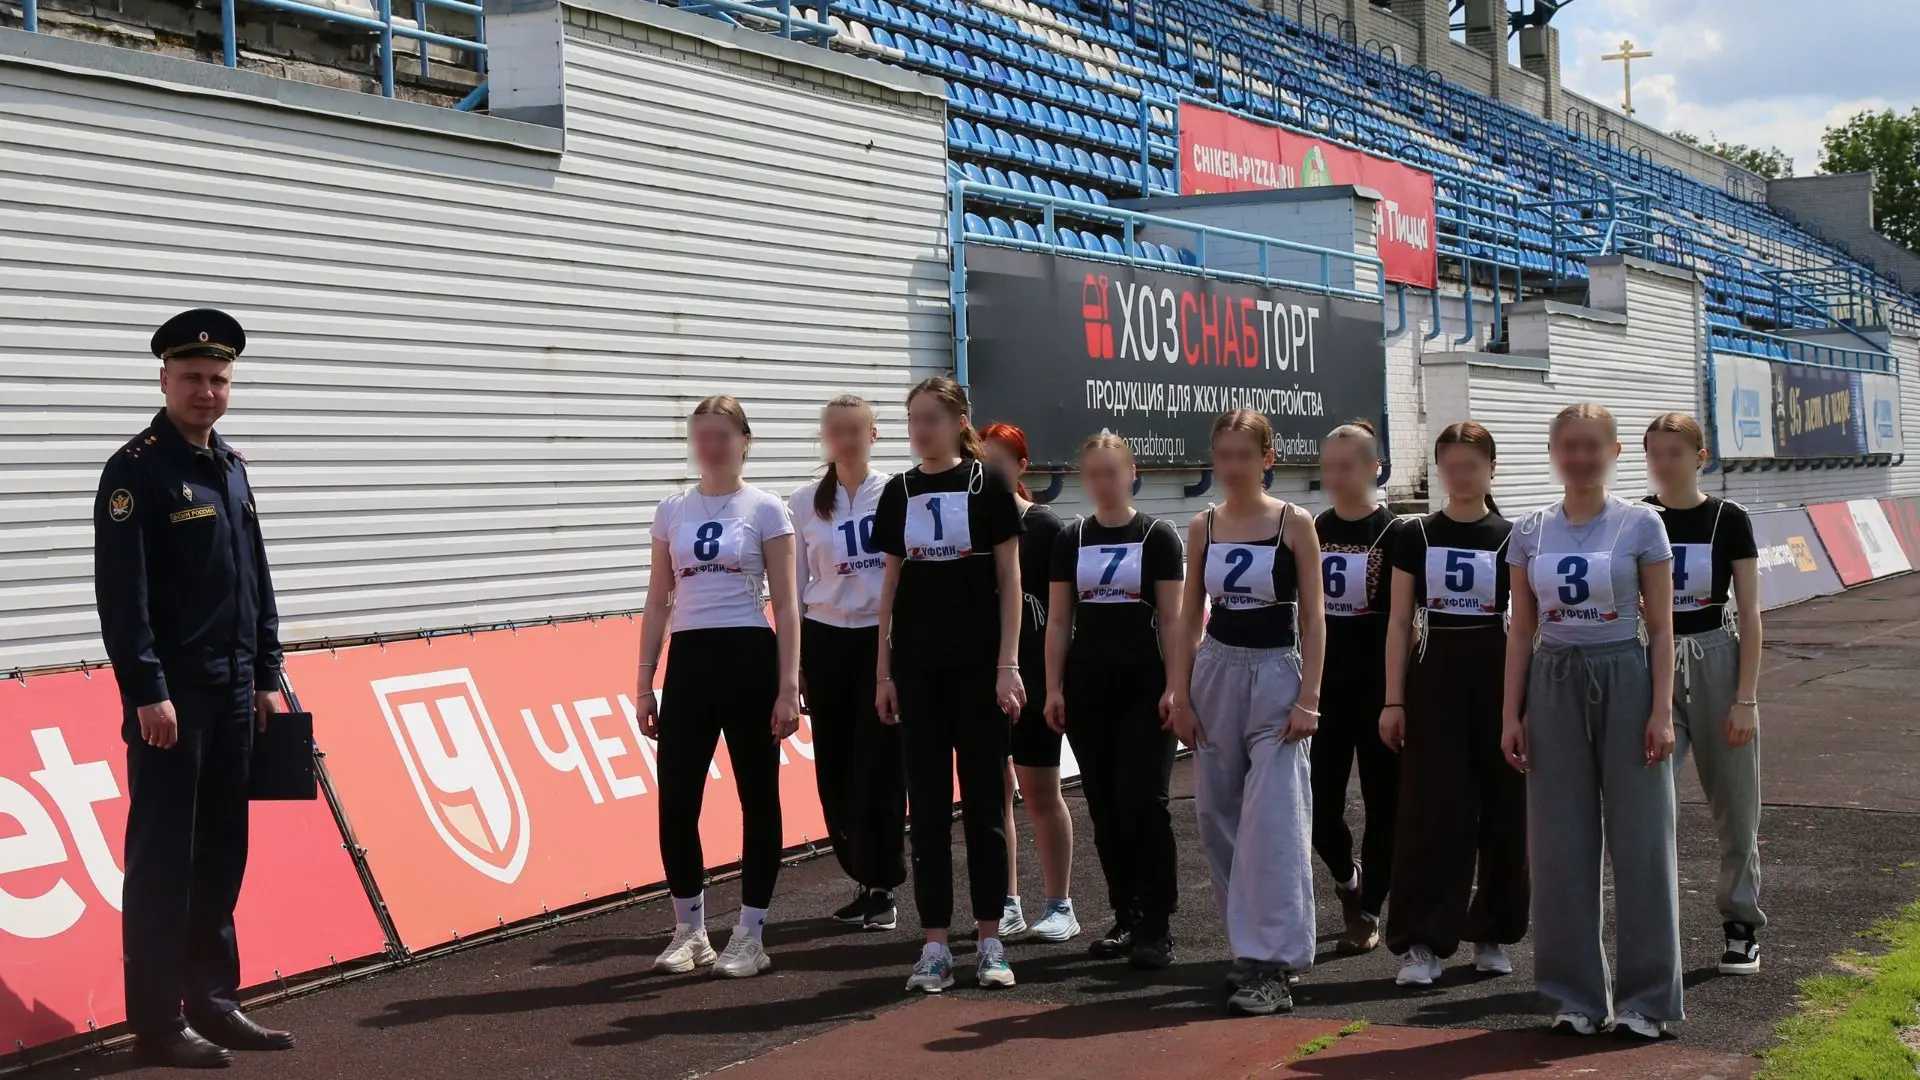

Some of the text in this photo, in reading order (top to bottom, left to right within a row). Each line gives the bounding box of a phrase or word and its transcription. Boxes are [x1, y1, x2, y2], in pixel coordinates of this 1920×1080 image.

[1193, 144, 1295, 189] CHIKEN-PIZZA.RU
[1385, 200, 1428, 251] Пицца
[1115, 281, 1320, 373] ХОЗСНАБТОРГ
[1086, 379, 1324, 418] ПРОДУКЦИЯ ДЛЯ ЖКХ И БЛАГОУСТРОЙСТВА
[1789, 387, 1801, 436] 95
[1116, 429, 1185, 463] ozsnabtorg.ru
[838, 515, 880, 557] 10
[925, 497, 944, 541] 1
[693, 521, 724, 562] 8
[921, 545, 956, 557] УФСИН
[849, 558, 881, 570] УФСИН
[1099, 547, 1128, 585] 7
[1223, 548, 1254, 594] 2
[1321, 555, 1348, 599] 6
[1445, 550, 1476, 593] 5
[1556, 555, 1590, 606] 3
[1325, 602, 1353, 612] ФСИН
[1441, 597, 1480, 608] УФСИН
[1559, 607, 1599, 620] УФСИН
